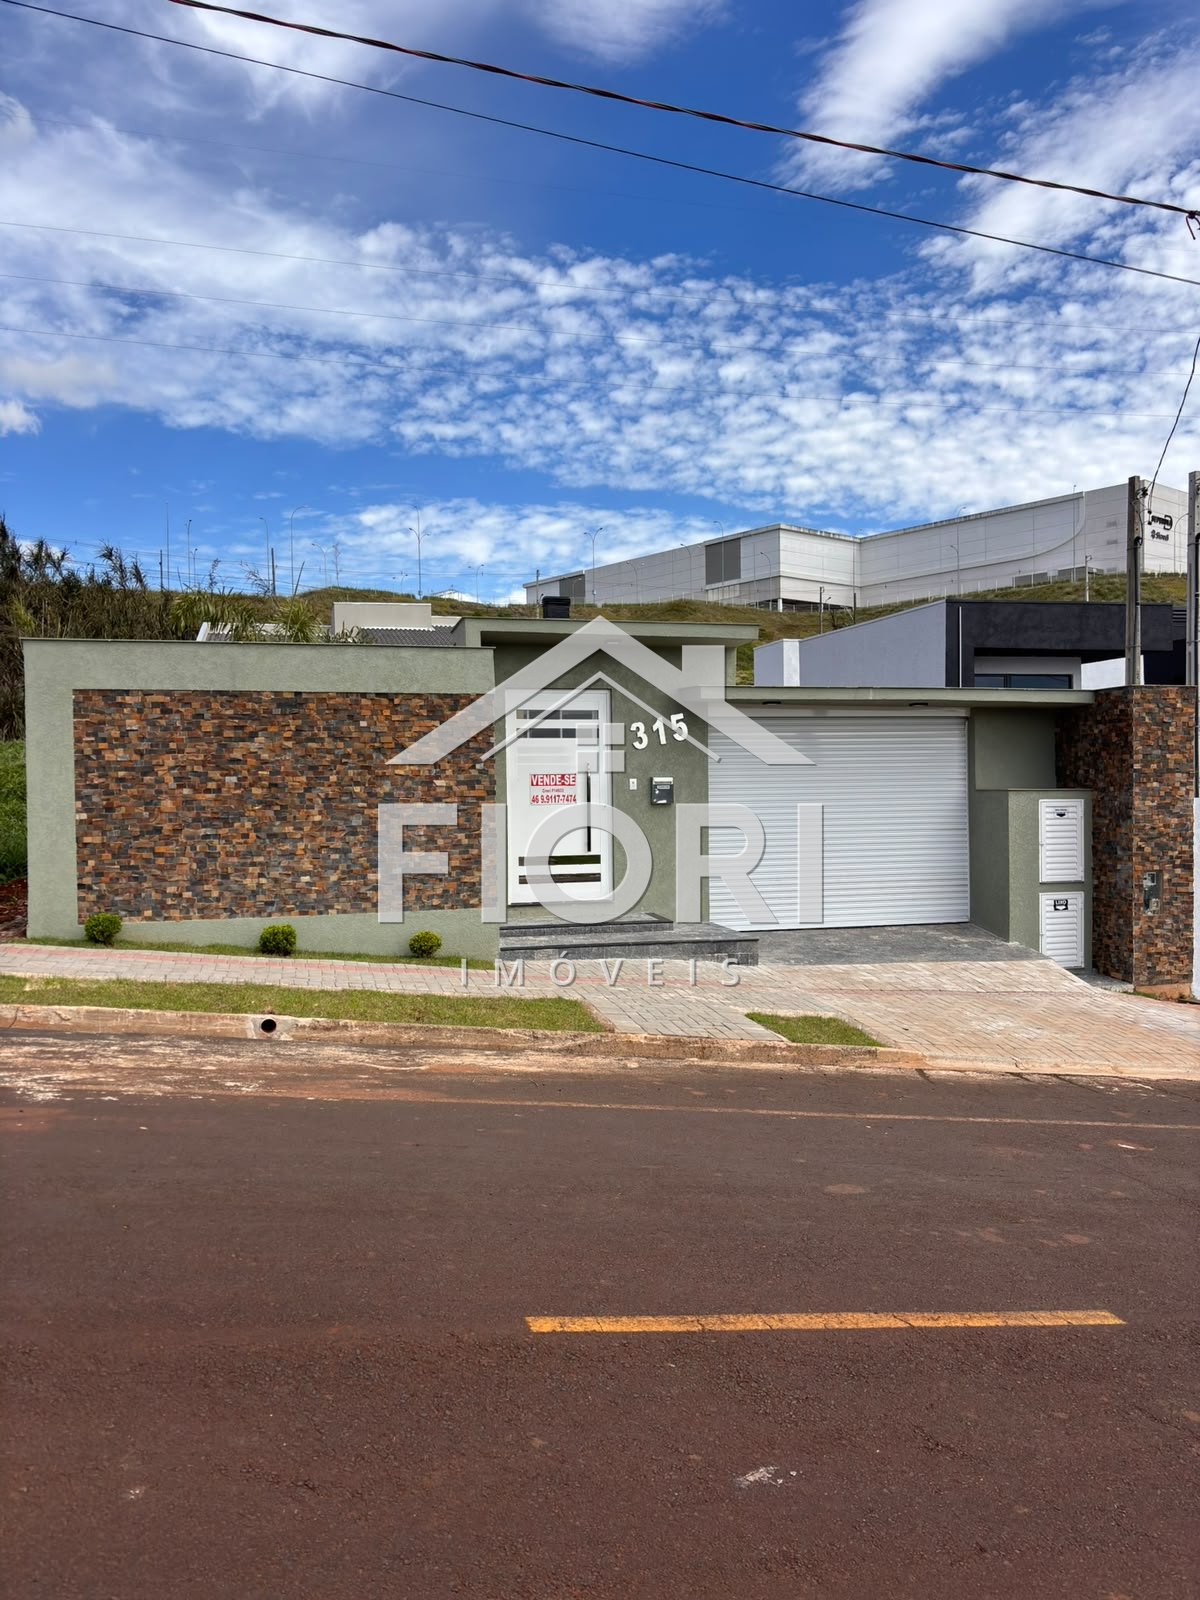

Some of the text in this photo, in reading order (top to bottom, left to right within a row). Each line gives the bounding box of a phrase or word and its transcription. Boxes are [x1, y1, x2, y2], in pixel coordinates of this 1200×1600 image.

[630, 713, 688, 750] 315
[531, 774, 576, 786] VENDE-SE
[531, 795, 539, 803] 46
